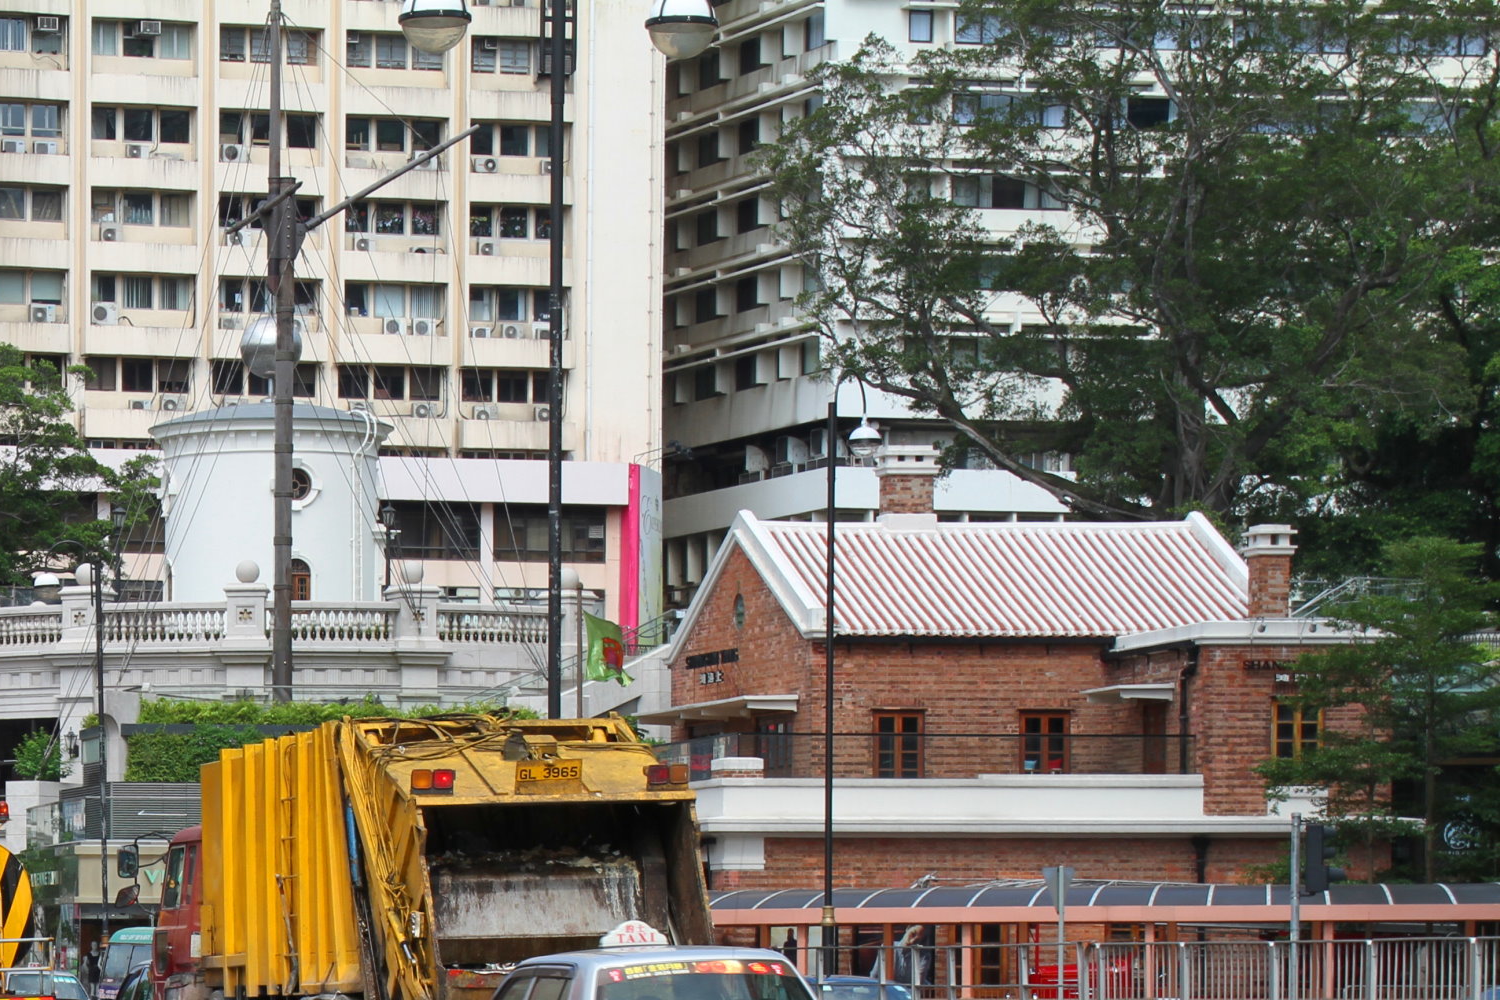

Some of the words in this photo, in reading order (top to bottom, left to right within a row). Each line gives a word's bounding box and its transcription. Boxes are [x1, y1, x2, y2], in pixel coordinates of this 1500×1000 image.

[520, 768, 536, 780] GL
[543, 766, 578, 778] 3965
[616, 933, 657, 944] TAXI
